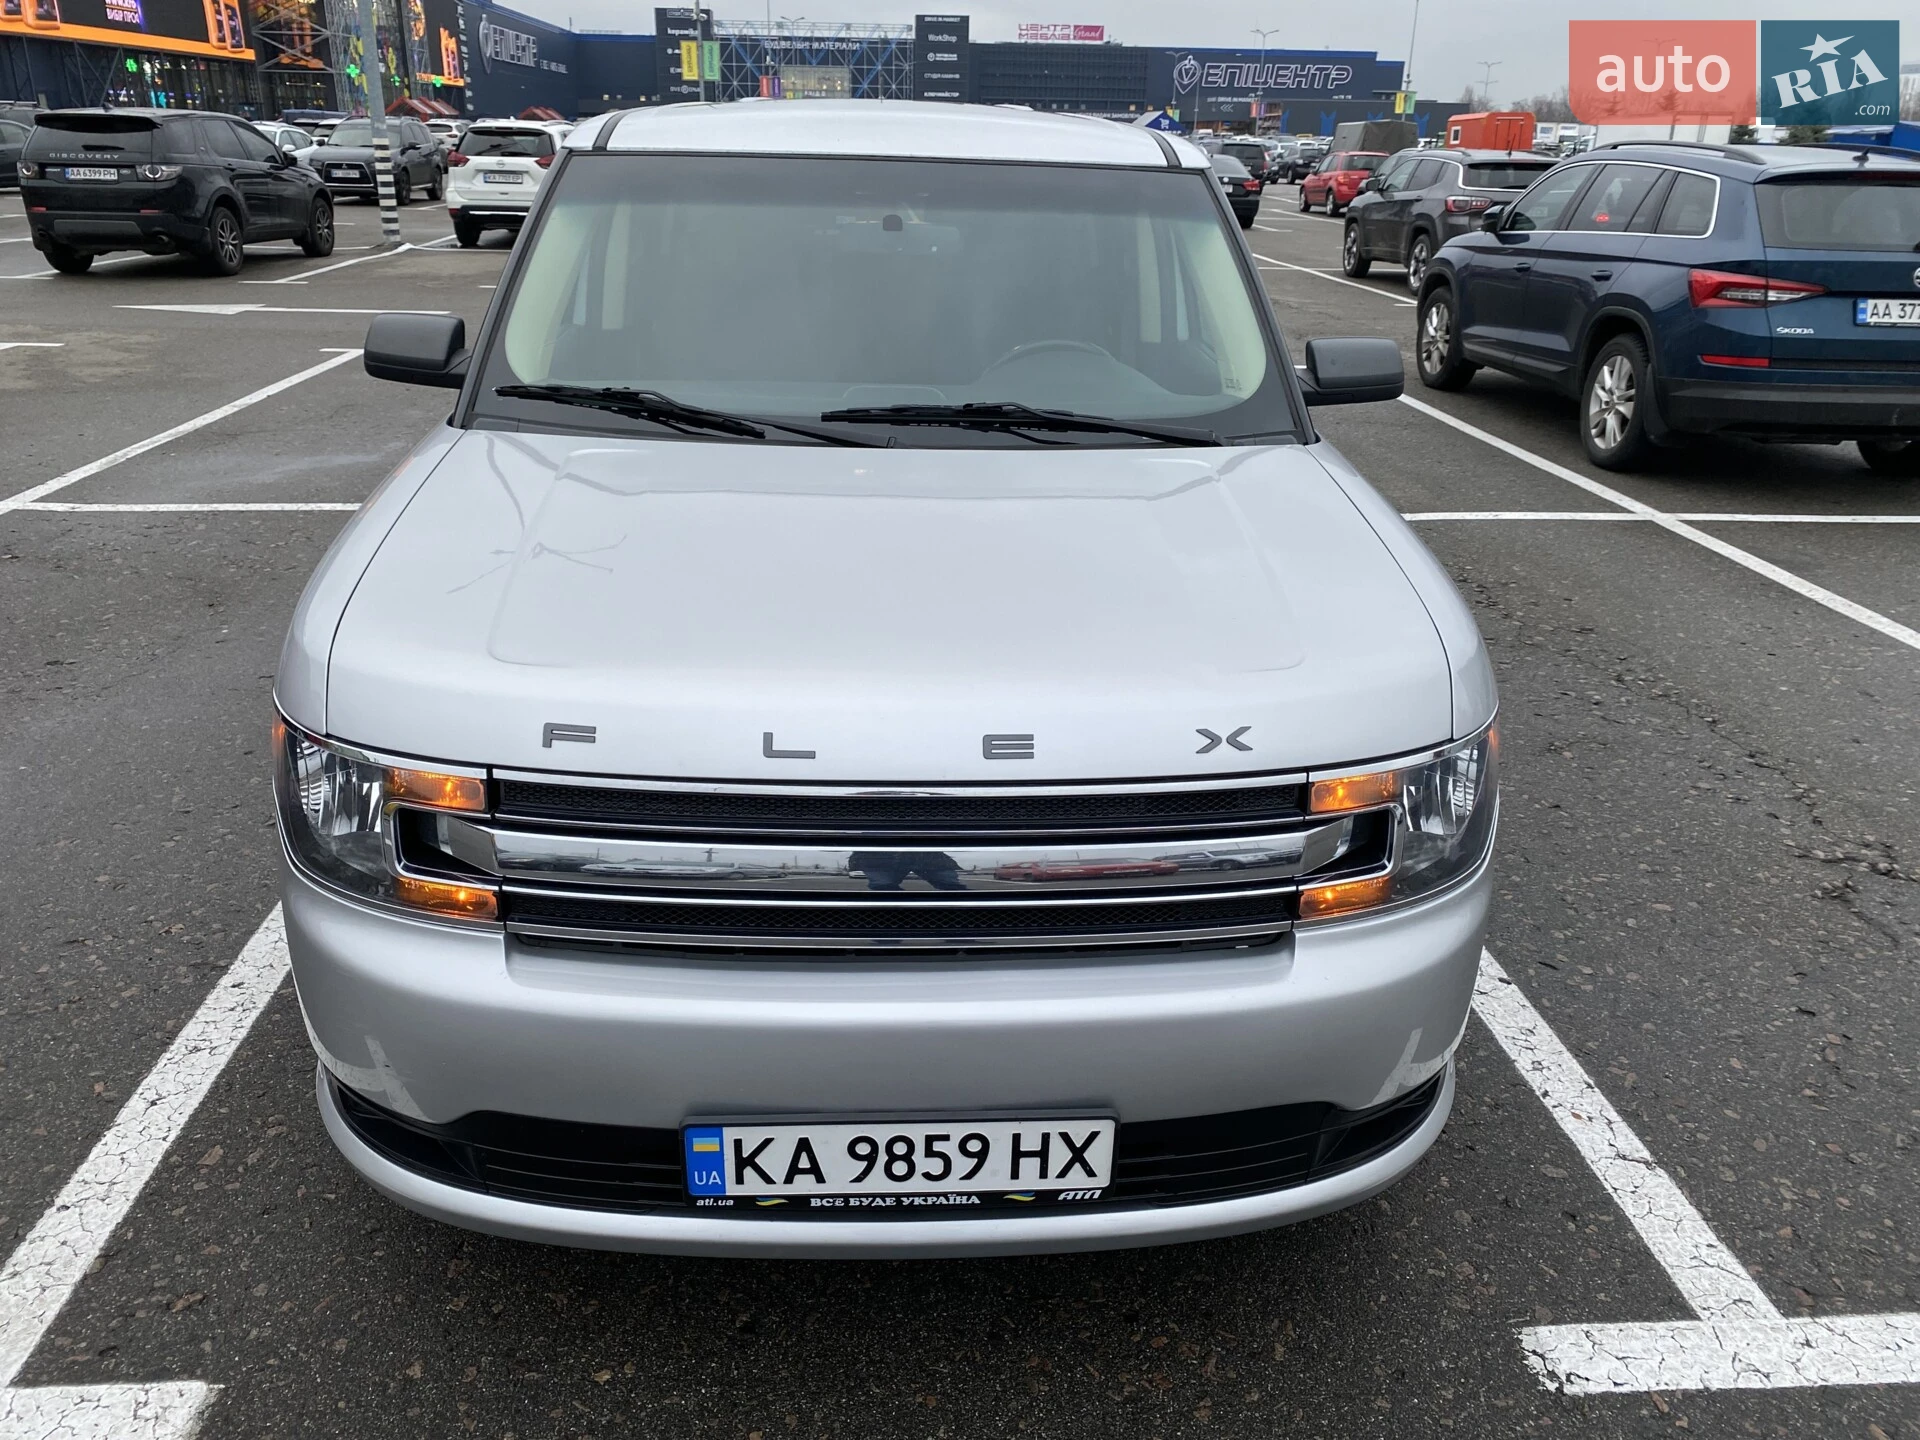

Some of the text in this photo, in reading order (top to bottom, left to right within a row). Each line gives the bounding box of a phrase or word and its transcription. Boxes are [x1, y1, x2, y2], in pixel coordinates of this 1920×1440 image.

[1018, 23, 1071, 32] ЦЕНТР
[1073, 25, 1103, 39] Grand
[811, 42, 860, 50] МАТЕРІАЛИ
[1201, 62, 1353, 89] ЕПІЦЕНТР
[70, 168, 82, 178] AA
[82, 168, 102, 178] 6399
[103, 168, 117, 178] PH
[1870, 302, 1893, 319] AA
[542, 722, 1253, 760] FLEX
[733, 1130, 1102, 1186] KA 9859 HX
[694, 1170, 722, 1187] UA
[696, 1197, 735, 1207] atl.ua
[810, 1193, 982, 1208] ВСЕ БУДЕ УКРАЇНА
